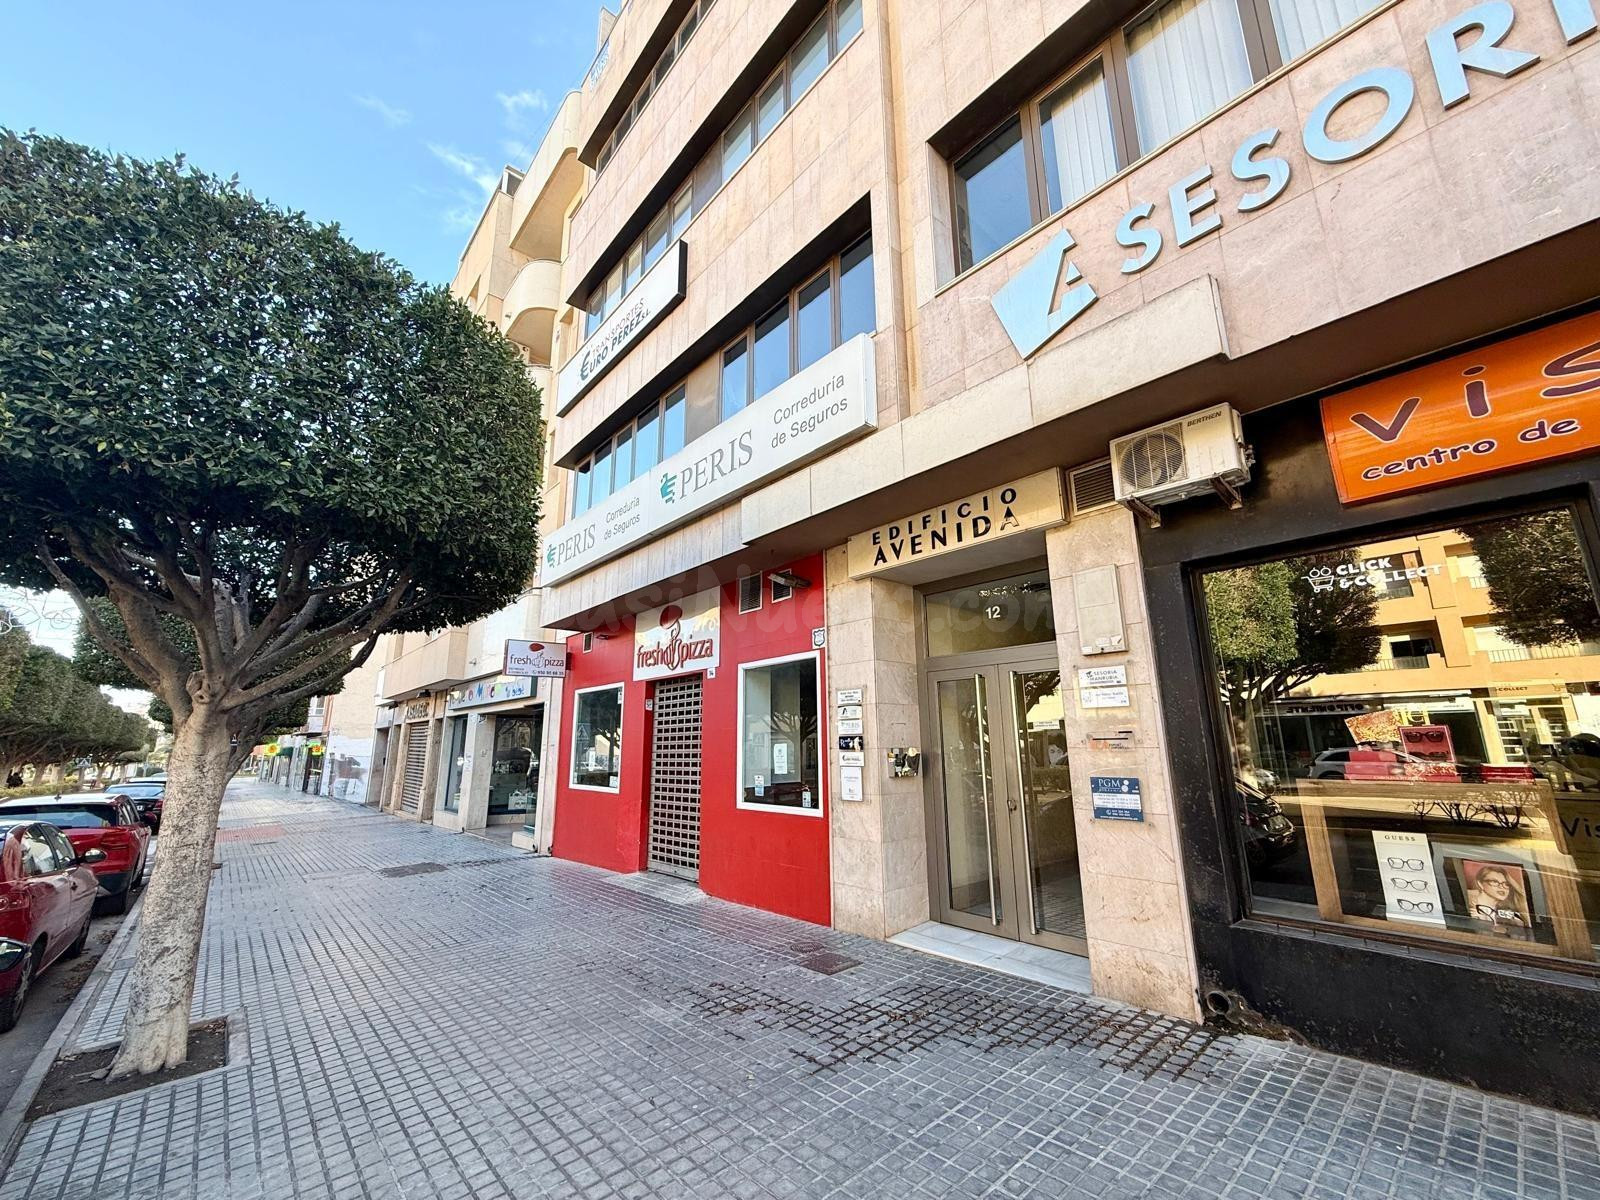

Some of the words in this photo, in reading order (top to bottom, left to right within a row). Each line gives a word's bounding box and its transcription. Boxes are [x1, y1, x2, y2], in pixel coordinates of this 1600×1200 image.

[592, 298, 644, 354] TRANSPORTES
[611, 311, 642, 351] PEREZ
[773, 374, 845, 424] Correduría
[771, 432, 787, 448] de
[790, 398, 848, 439] Seguros
[1187, 411, 1221, 427] BERTHEN
[680, 429, 753, 499] PERIS
[1361, 439, 1497, 480] centro
[1517, 418, 1580, 443] de
[604, 529, 612, 540] de
[613, 514, 640, 535] Seguros
[606, 497, 640, 523] Correduría
[872, 488, 1017, 546] EDIFICIO
[556, 523, 596, 567] PERIS
[874, 506, 1021, 567] AVENIDA
[1336, 557, 1392, 576] CLICK
[985, 605, 1001, 620] 12
[510, 654, 531, 665] fresh
[544, 657, 564, 668] pizza
[637, 641, 664, 668] fresh
[680, 634, 714, 668] pizza
[1098, 779, 1121, 788] PGM
[1384, 834, 1416, 842] GUESS
